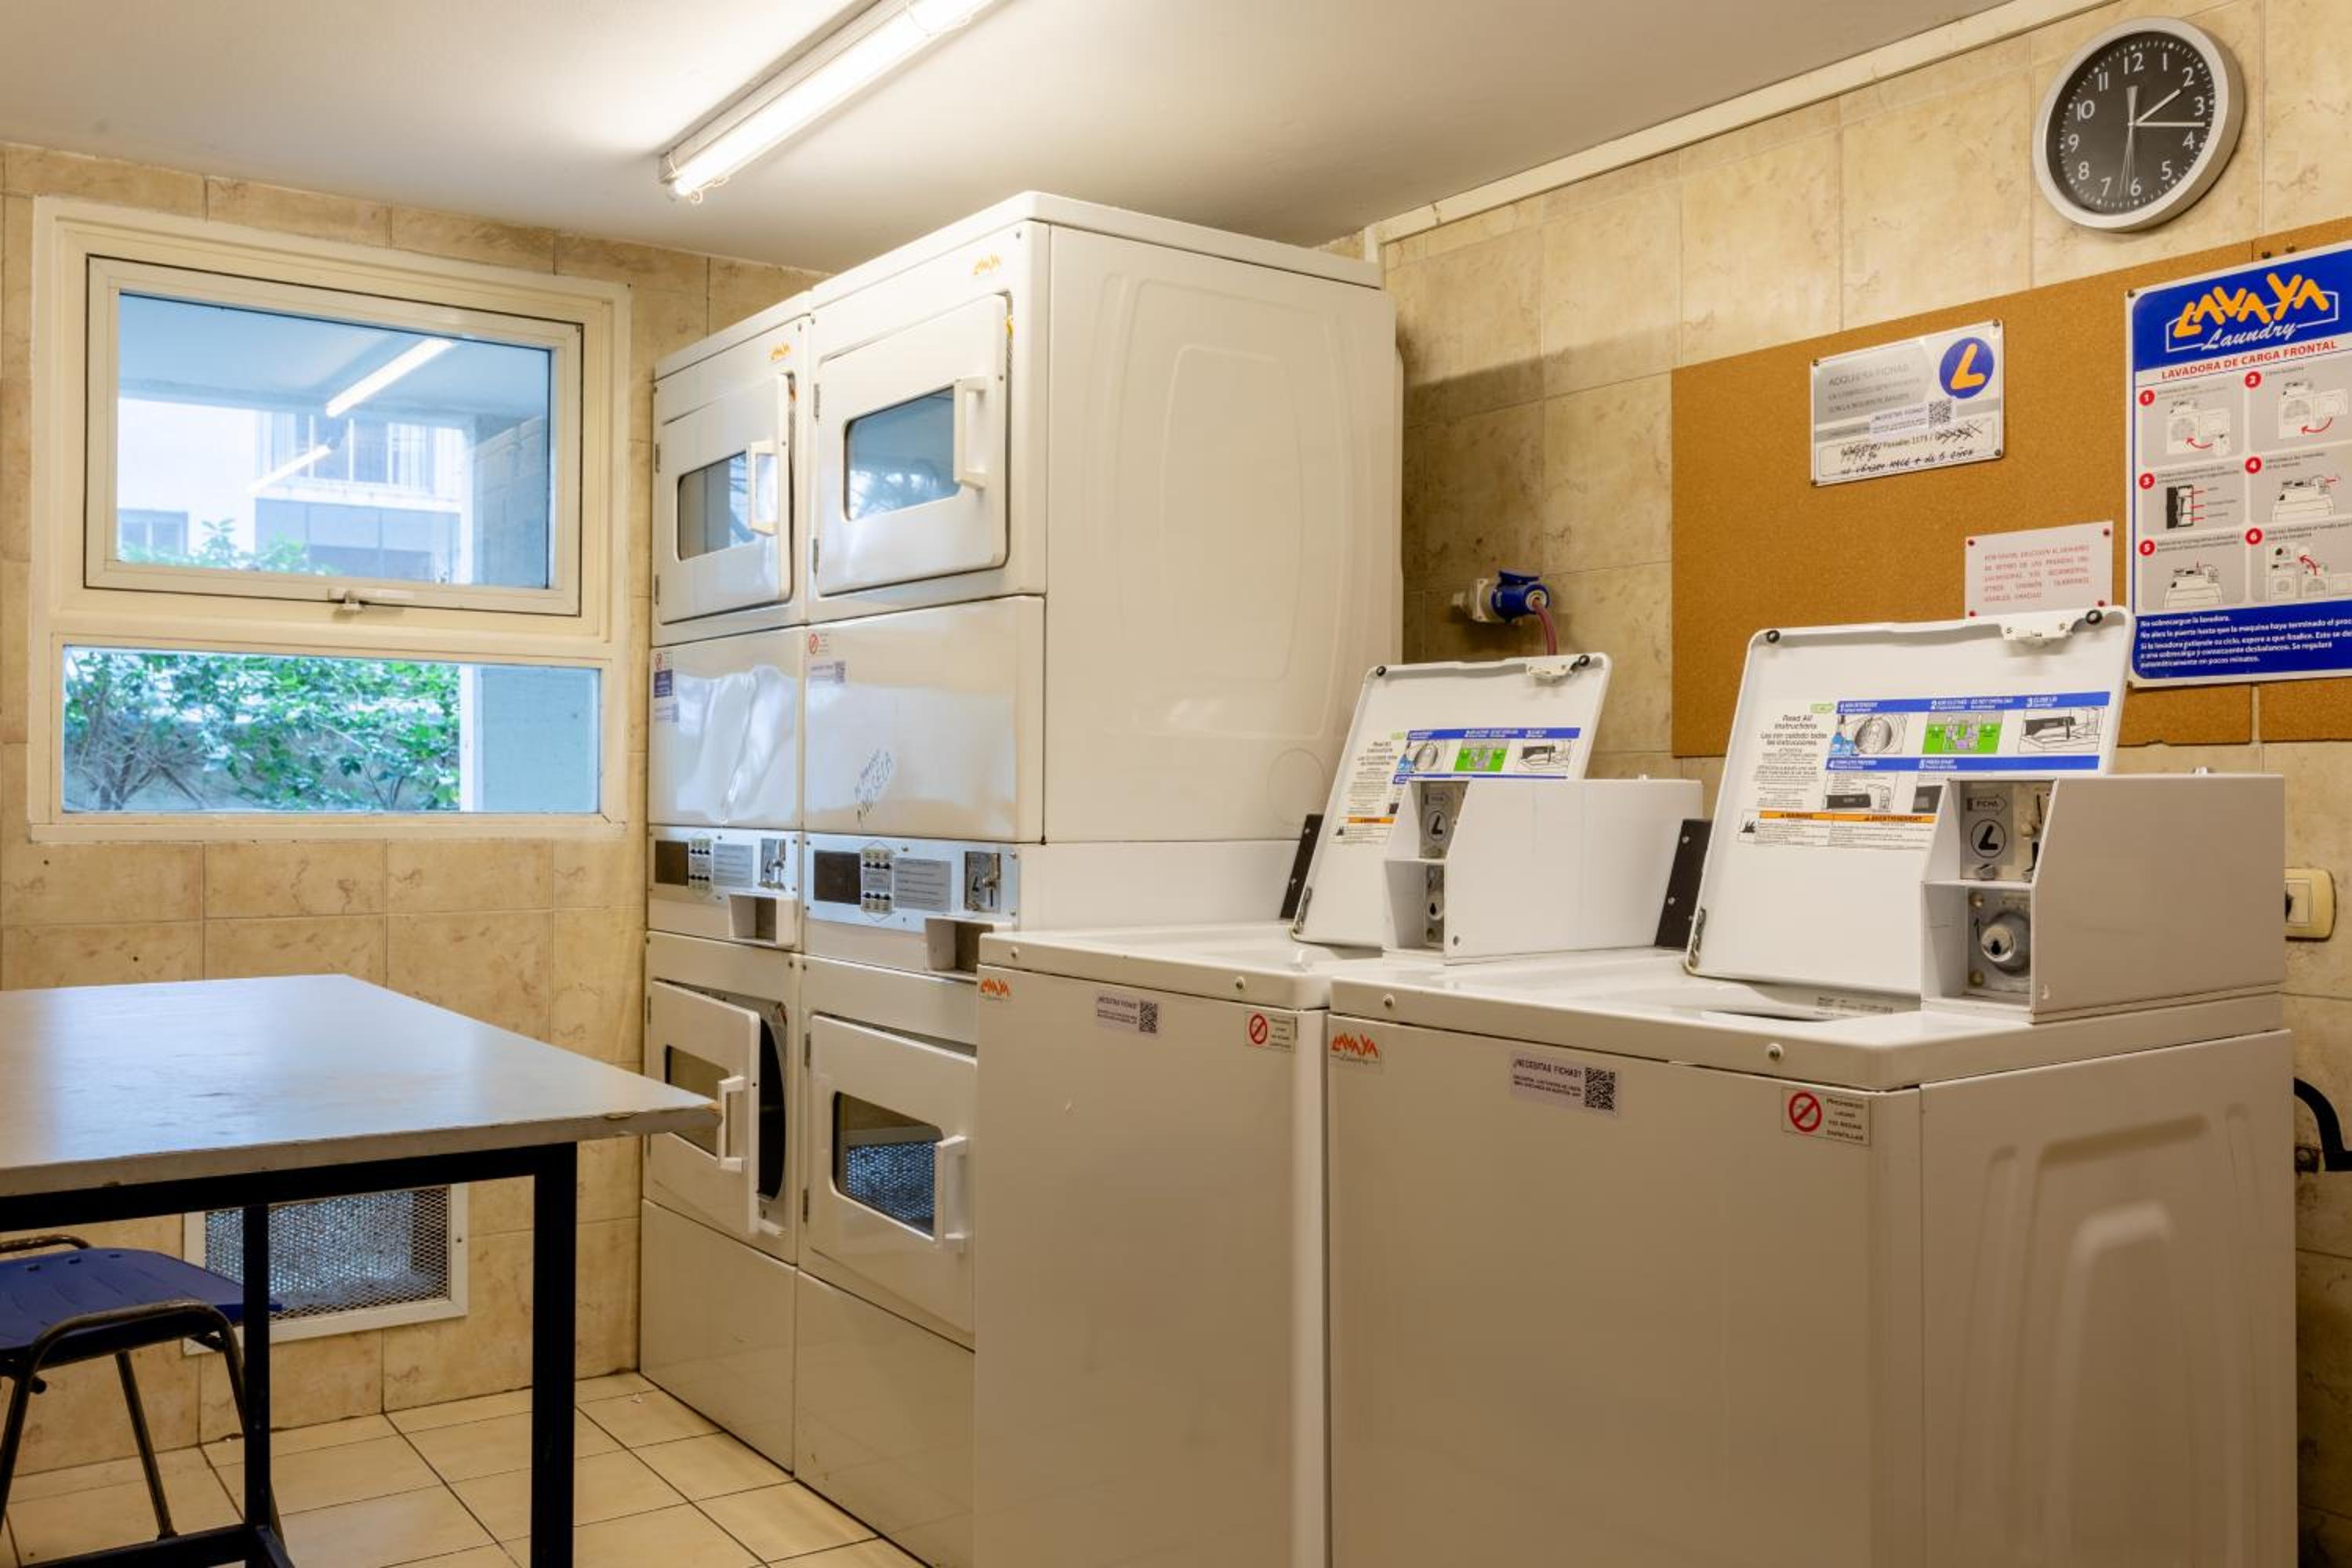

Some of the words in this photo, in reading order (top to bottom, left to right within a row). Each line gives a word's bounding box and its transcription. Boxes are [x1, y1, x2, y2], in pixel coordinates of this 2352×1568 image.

[2124, 53, 2144, 74] 12
[2162, 53, 2167, 71] 1
[2098, 72, 2108, 92] 11
[2182, 67, 2194, 87] 2
[2076, 100, 2095, 121] 10
[2194, 96, 2205, 115] 3
[2068, 134, 2079, 152] 9
[2183, 131, 2195, 150] 4
[2078, 162, 2089, 180] 8
[2161, 161, 2172, 180] 5
[2101, 177, 2111, 196] 7
[2131, 179, 2141, 196] 6
[2173, 273, 2329, 337] LAVAYA
[2201, 321, 2296, 350] Laundry
[1951, 343, 1986, 390] L
[2161, 361, 2221, 380] LAVADORA
[2224, 357, 2238, 368] DE
[2241, 351, 2280, 365] CARGA
[2283, 341, 2338, 358] FRONTAL
[2288, 619, 2326, 627] terminado
[1979, 825, 1998, 851] L
